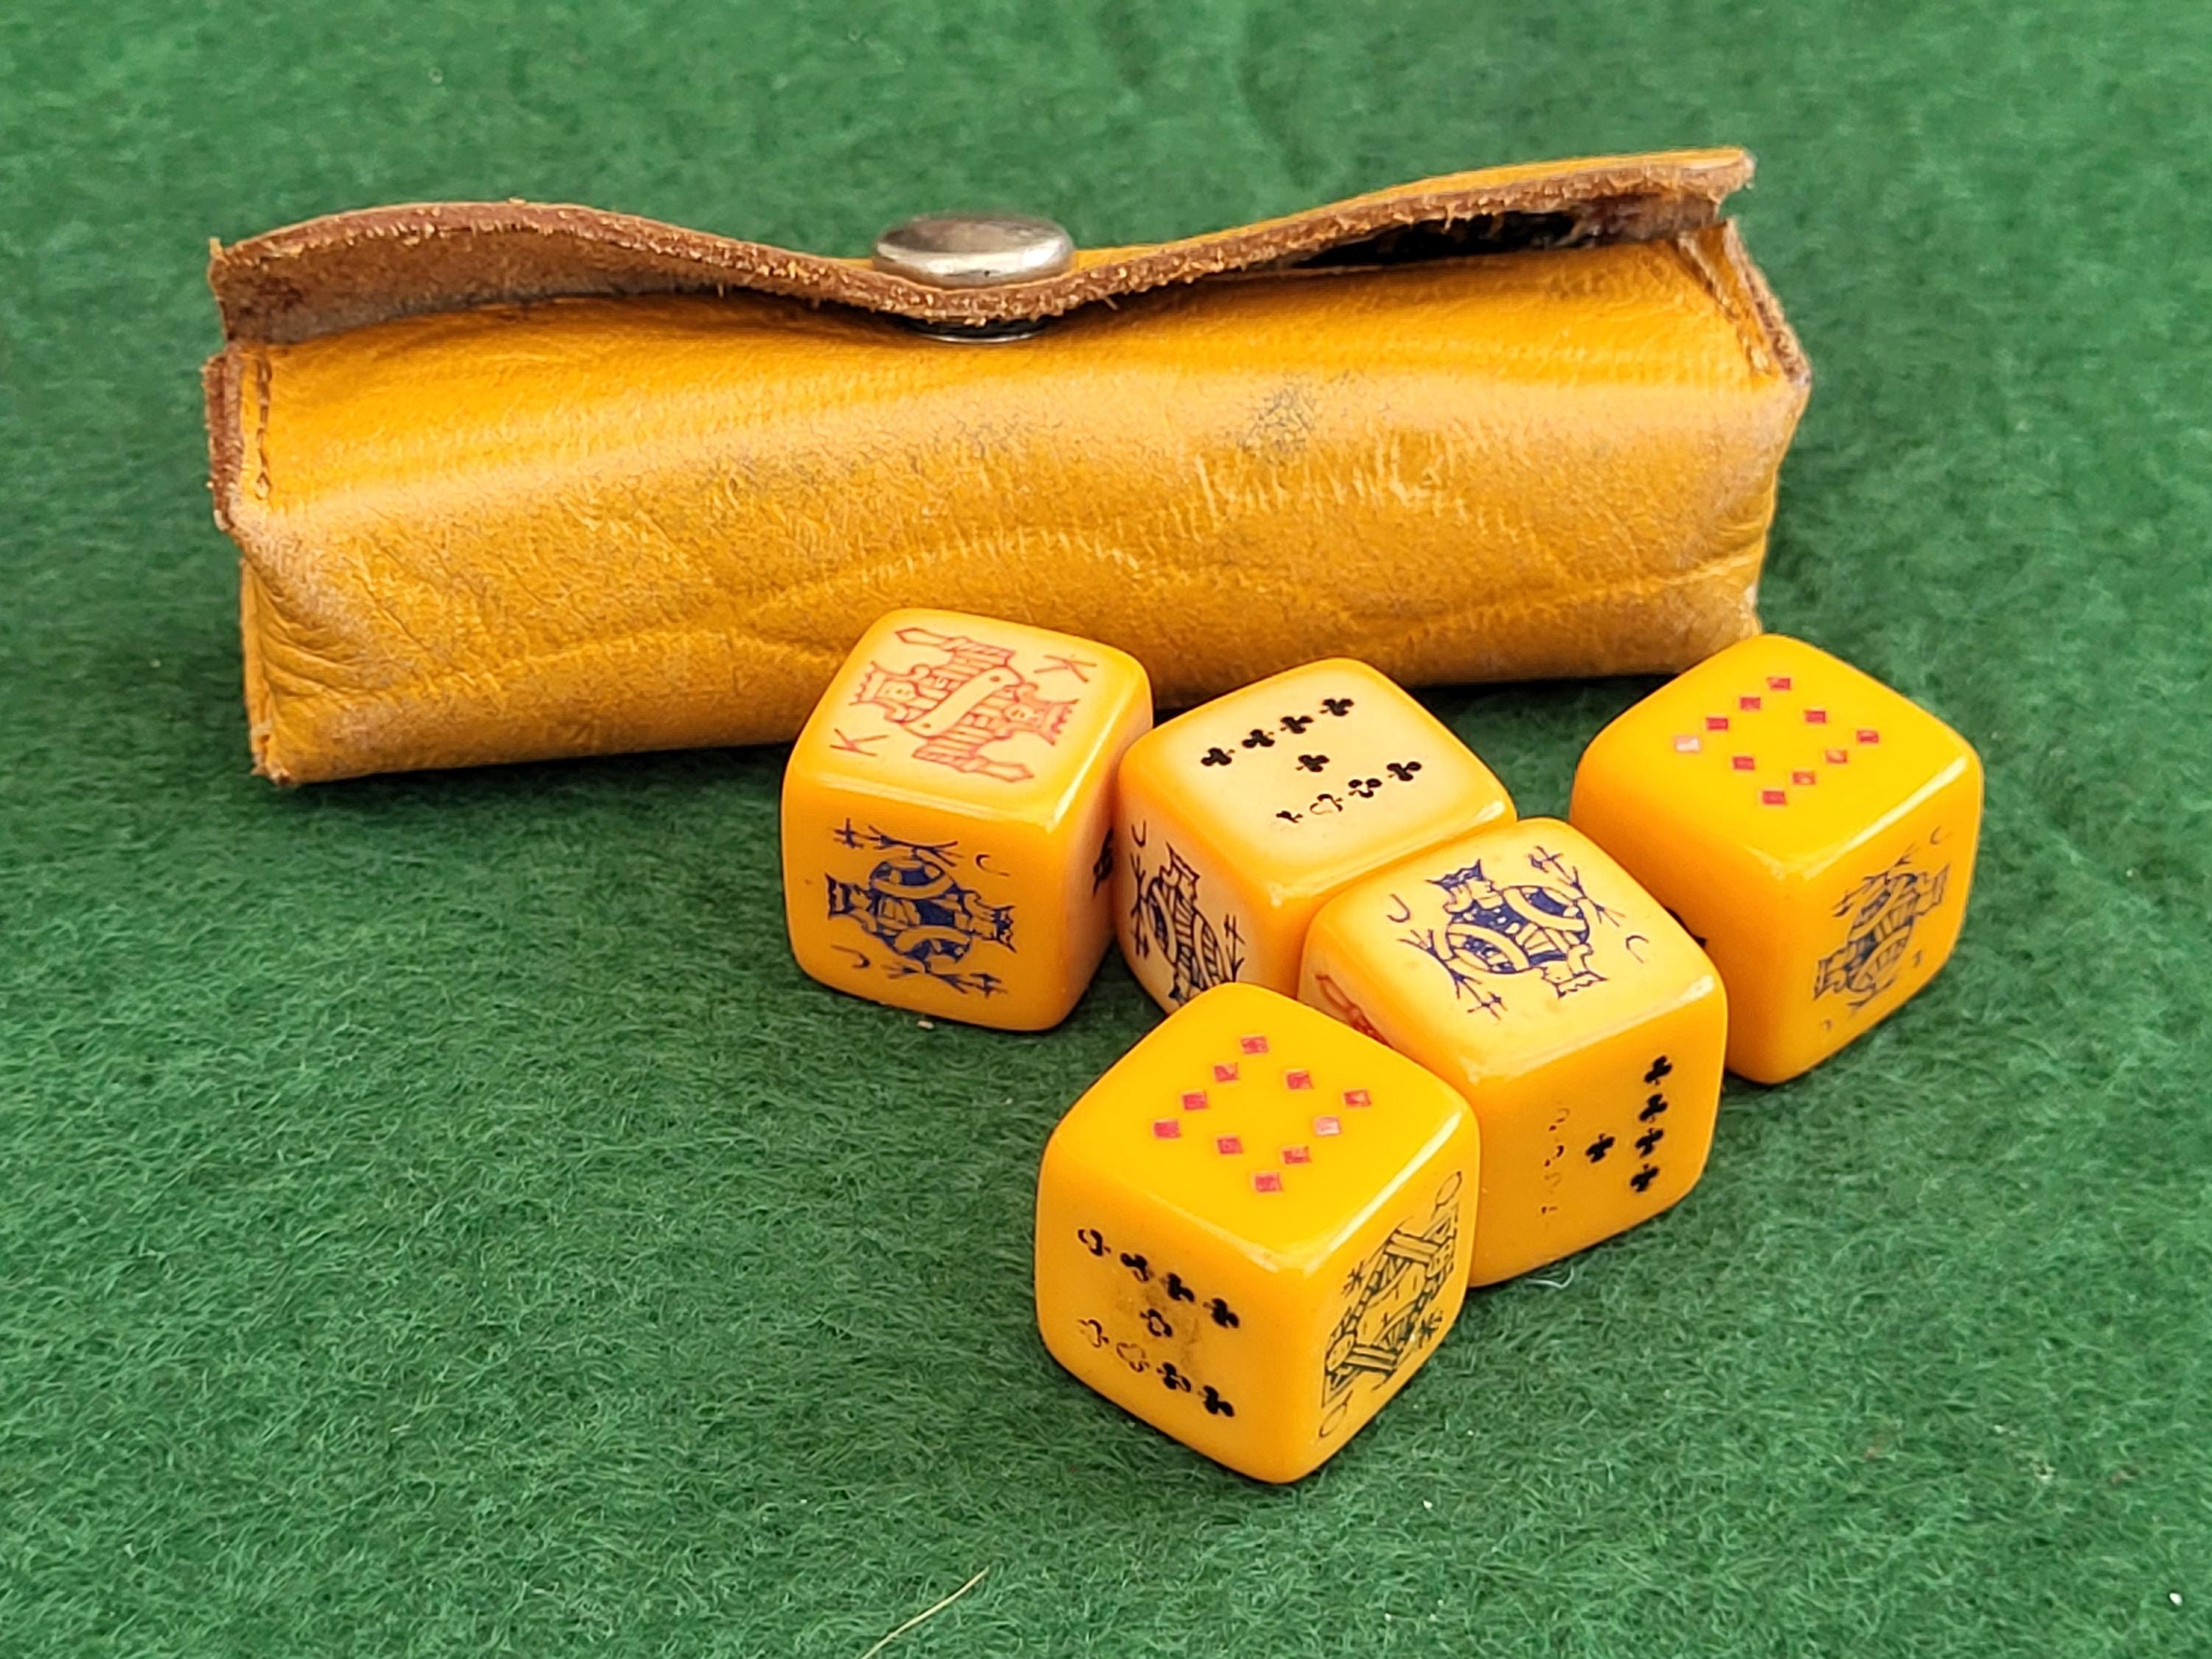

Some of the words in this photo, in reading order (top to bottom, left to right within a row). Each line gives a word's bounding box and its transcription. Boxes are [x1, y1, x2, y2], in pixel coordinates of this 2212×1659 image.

[1034, 654, 1097, 683] K
[829, 728, 889, 757] K
[1385, 894, 1411, 923] J
